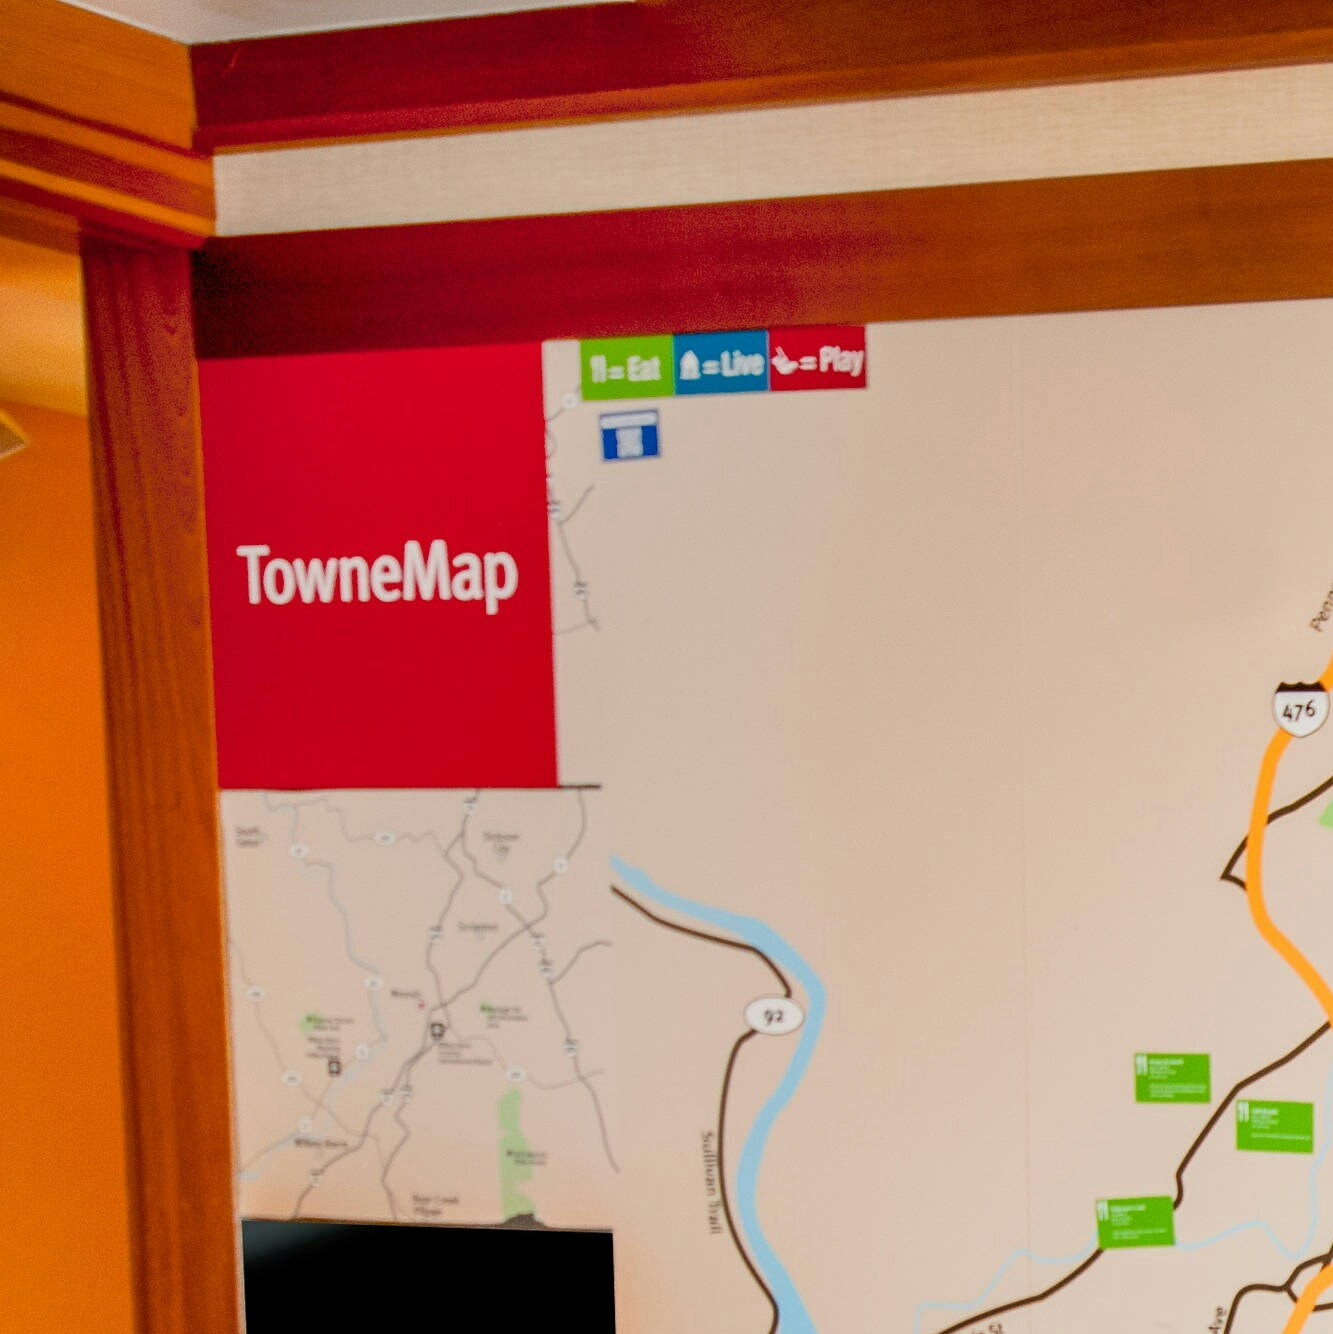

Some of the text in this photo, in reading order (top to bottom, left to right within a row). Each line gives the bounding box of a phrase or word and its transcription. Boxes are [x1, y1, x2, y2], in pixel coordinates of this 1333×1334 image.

[236, 539, 518, 615] TowneMap
[1282, 700, 1316, 722] 476
[763, 1009, 784, 1026] 92
[703, 1129, 723, 1234] Sullivan Trail
